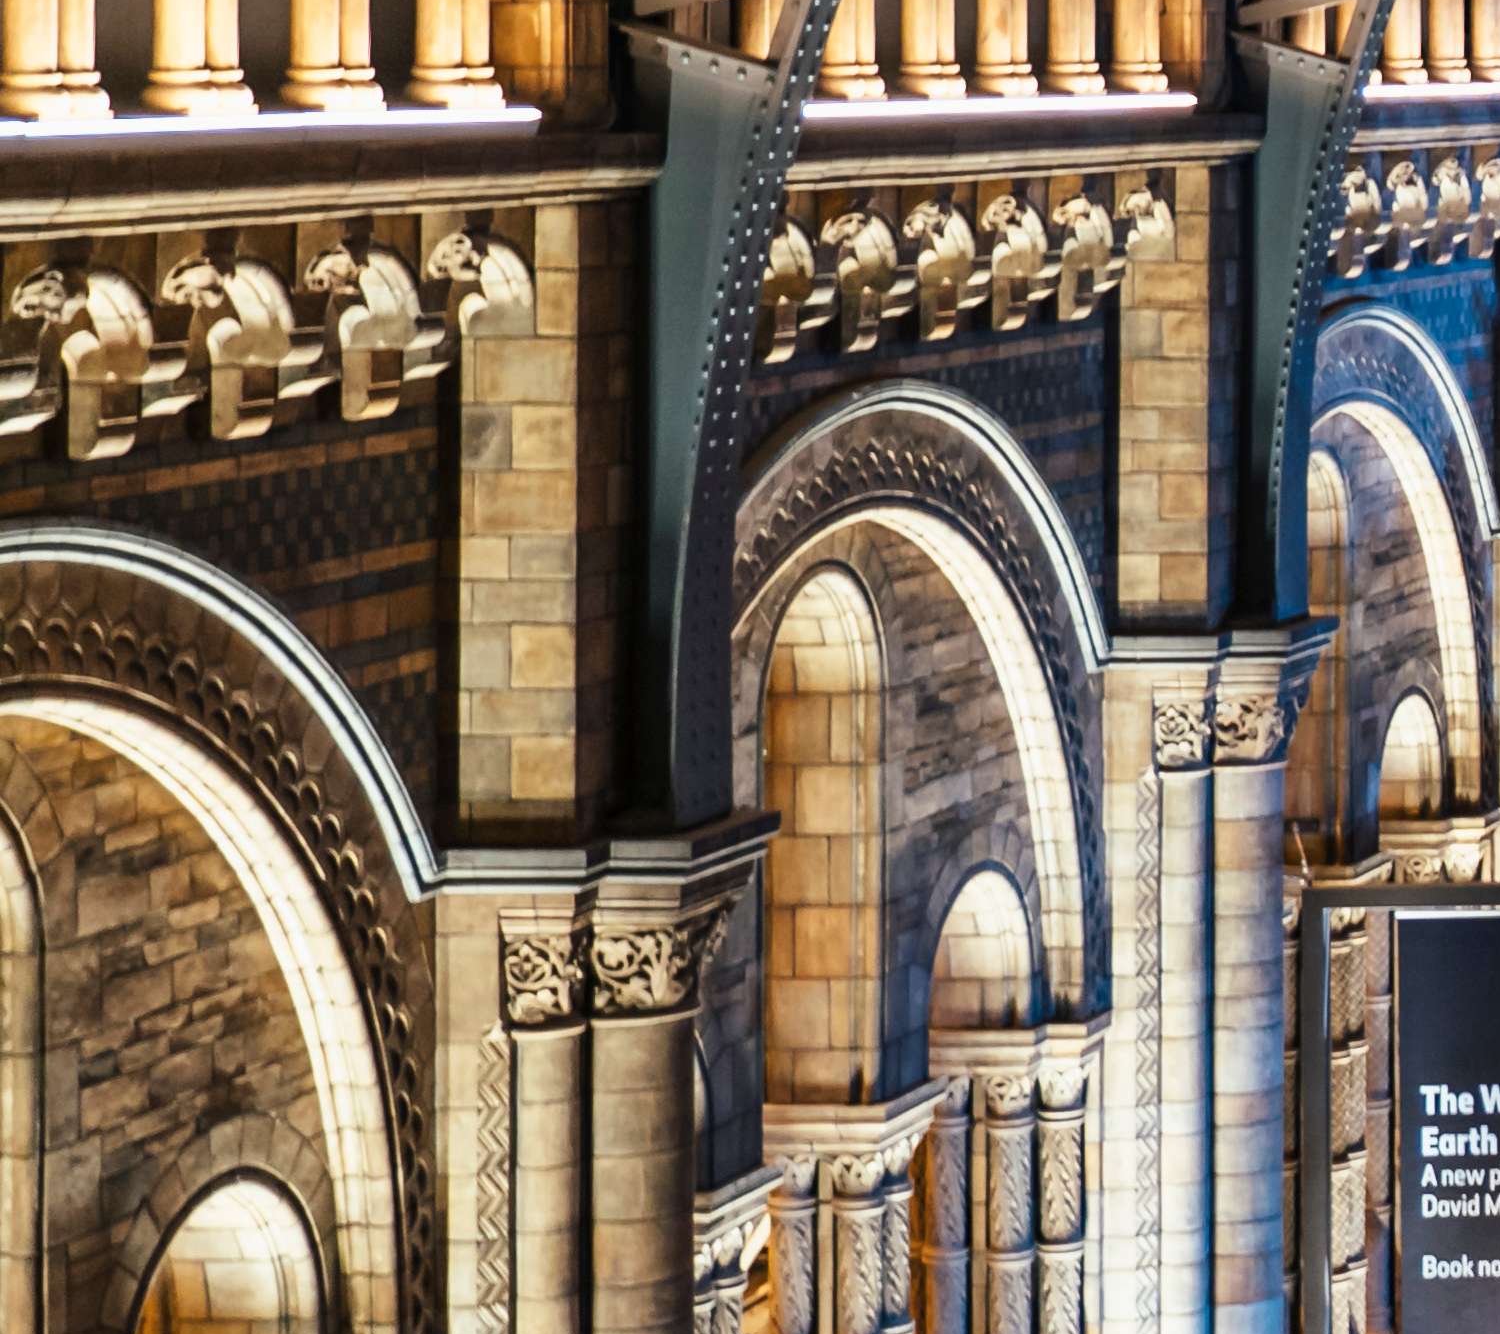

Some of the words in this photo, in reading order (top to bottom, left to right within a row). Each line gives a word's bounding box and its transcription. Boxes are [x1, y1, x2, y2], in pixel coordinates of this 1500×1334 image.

[1419, 1083, 1474, 1115] The
[1420, 1124, 1498, 1157] Earth
[1421, 1163, 1437, 1187] A
[1441, 1168, 1485, 1187] new
[1421, 1193, 1480, 1218] David
[1421, 1254, 1474, 1279] Book
